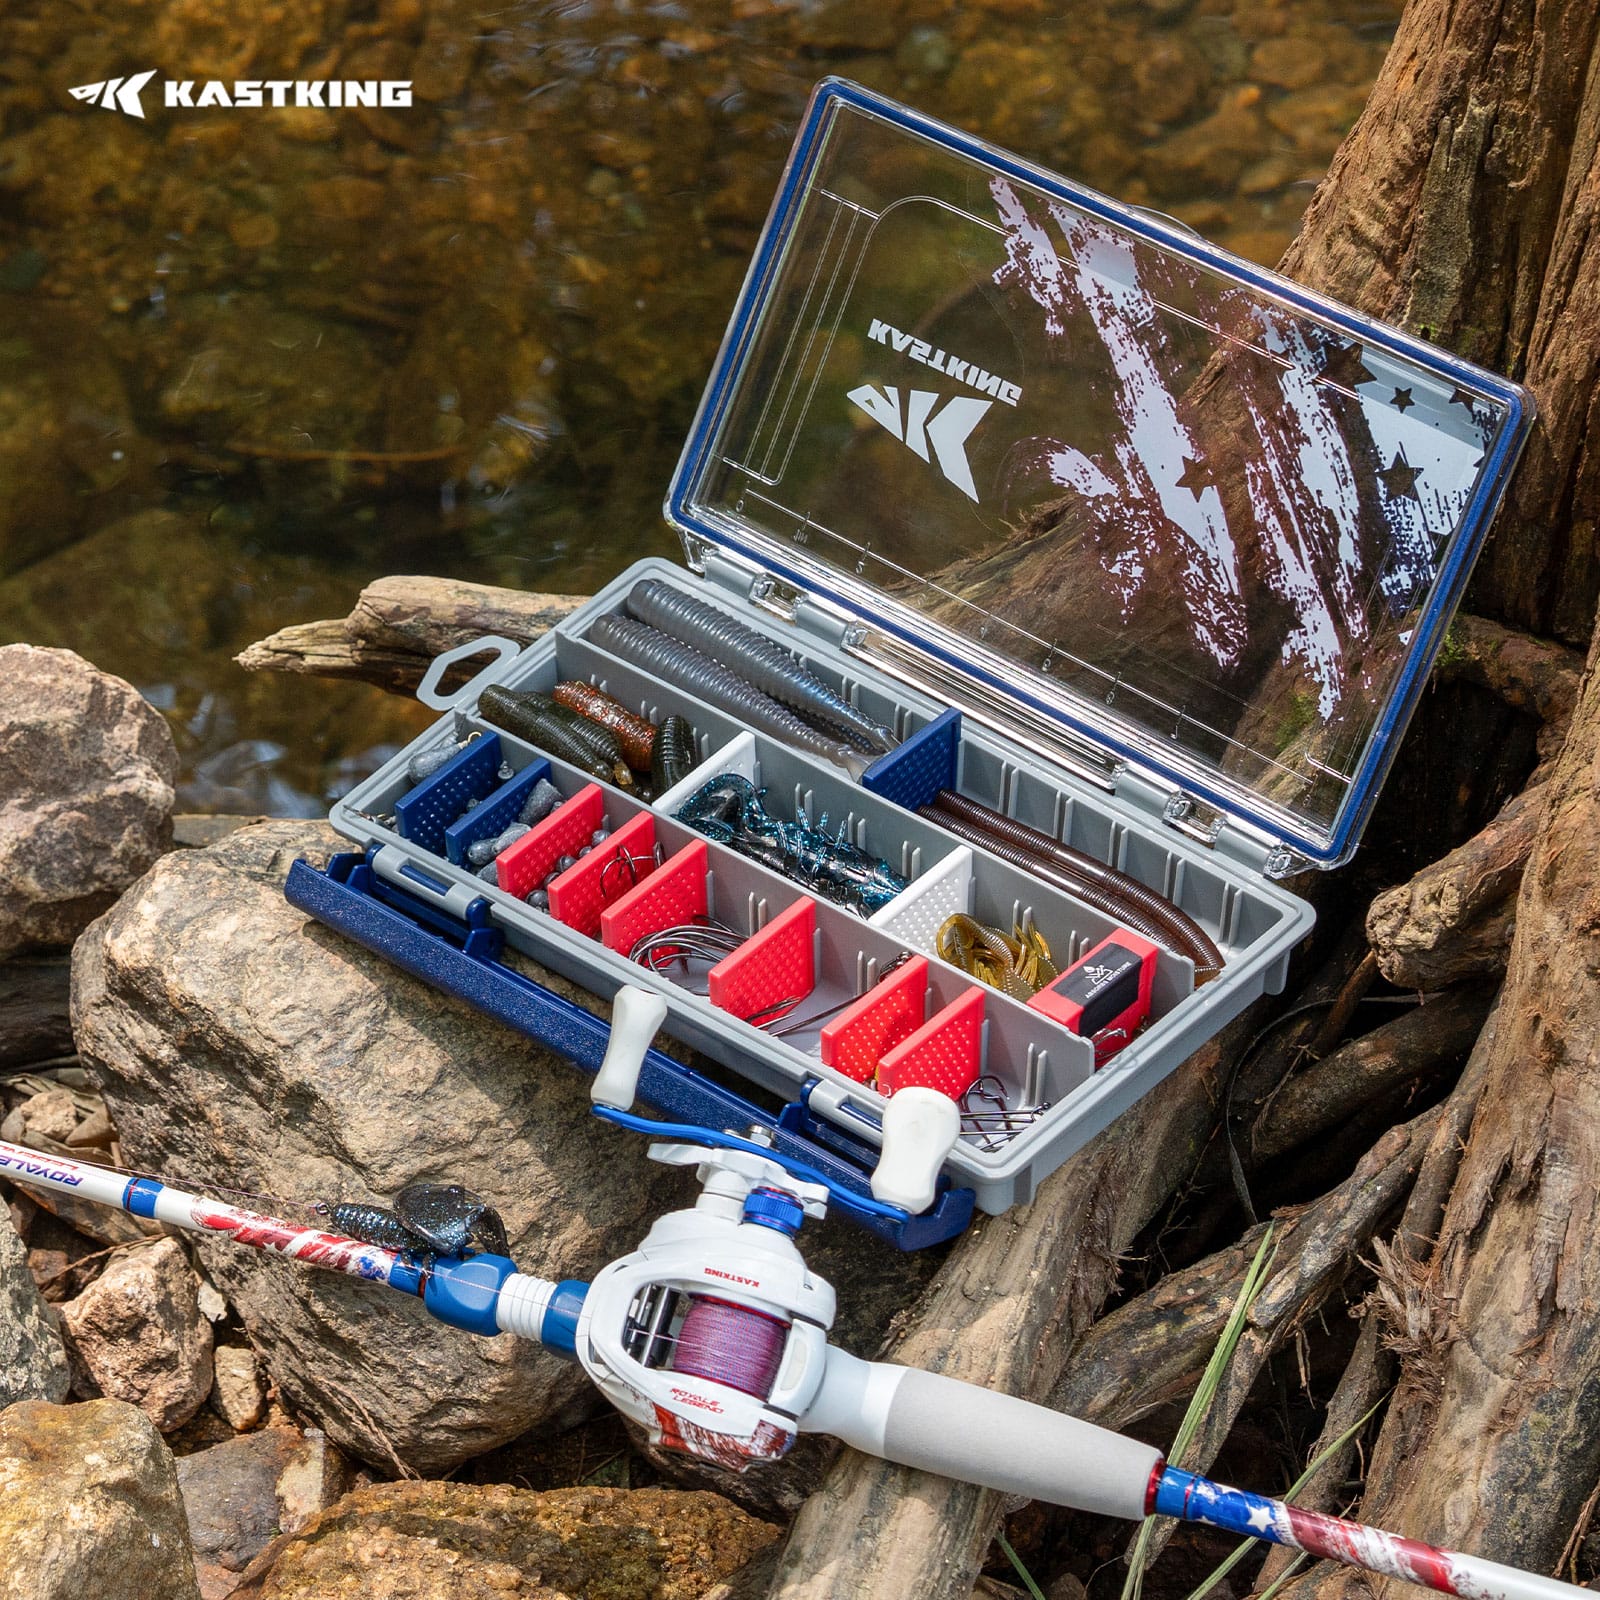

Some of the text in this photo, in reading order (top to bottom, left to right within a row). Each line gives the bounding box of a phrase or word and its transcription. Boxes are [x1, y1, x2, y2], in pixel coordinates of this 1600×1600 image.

[704, 1267, 760, 1288] KASTKING
[670, 1387, 721, 1407] ROYALE
[672, 1395, 725, 1414] LEGEND
